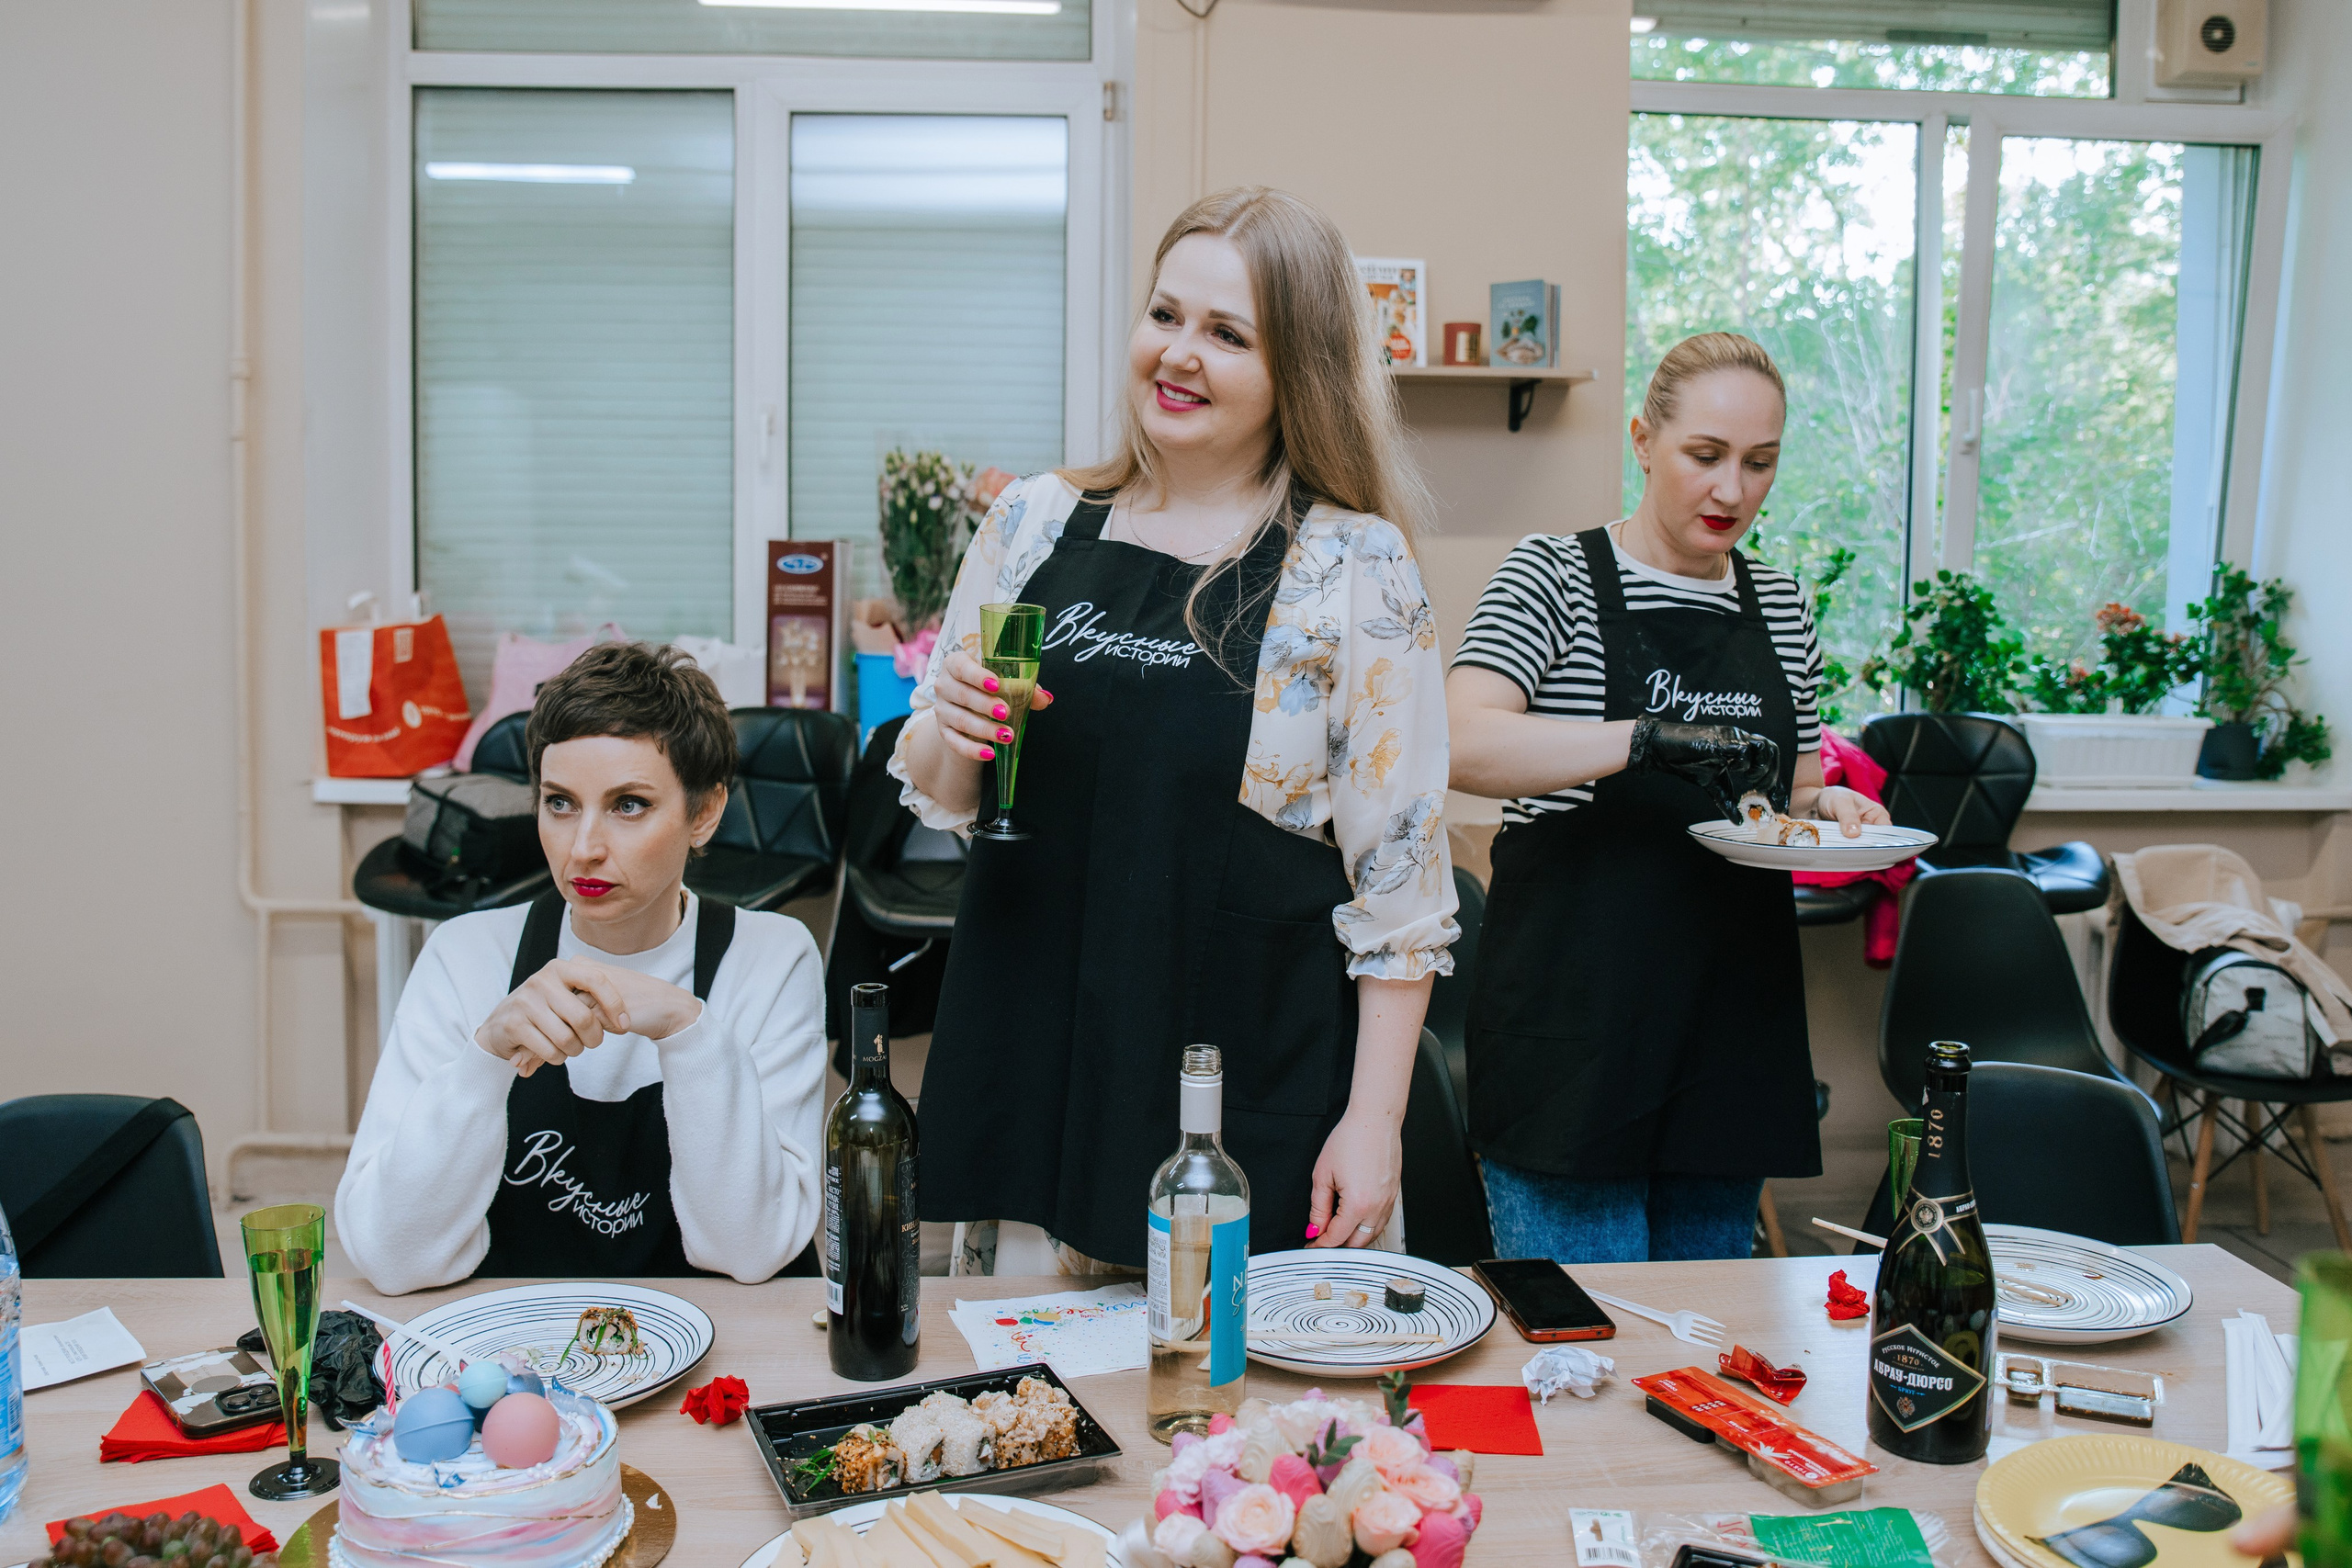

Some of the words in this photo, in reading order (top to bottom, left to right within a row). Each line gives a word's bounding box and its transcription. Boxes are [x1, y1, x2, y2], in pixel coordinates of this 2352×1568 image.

[1041, 602, 1204, 662] Вкусные
[1645, 669, 1762, 722] Вкусные
[1927, 1108, 1945, 1159] 1870
[503, 1130, 650, 1217] Вкусные
[1873, 1359, 1954, 1392] АБРАУ-ДЮРСО
[1881, 1344, 1905, 1354] РУССКОЕ
[1906, 1345, 1941, 1369] ИГРИСТОЕ
[1896, 1354, 1920, 1366] 1870
